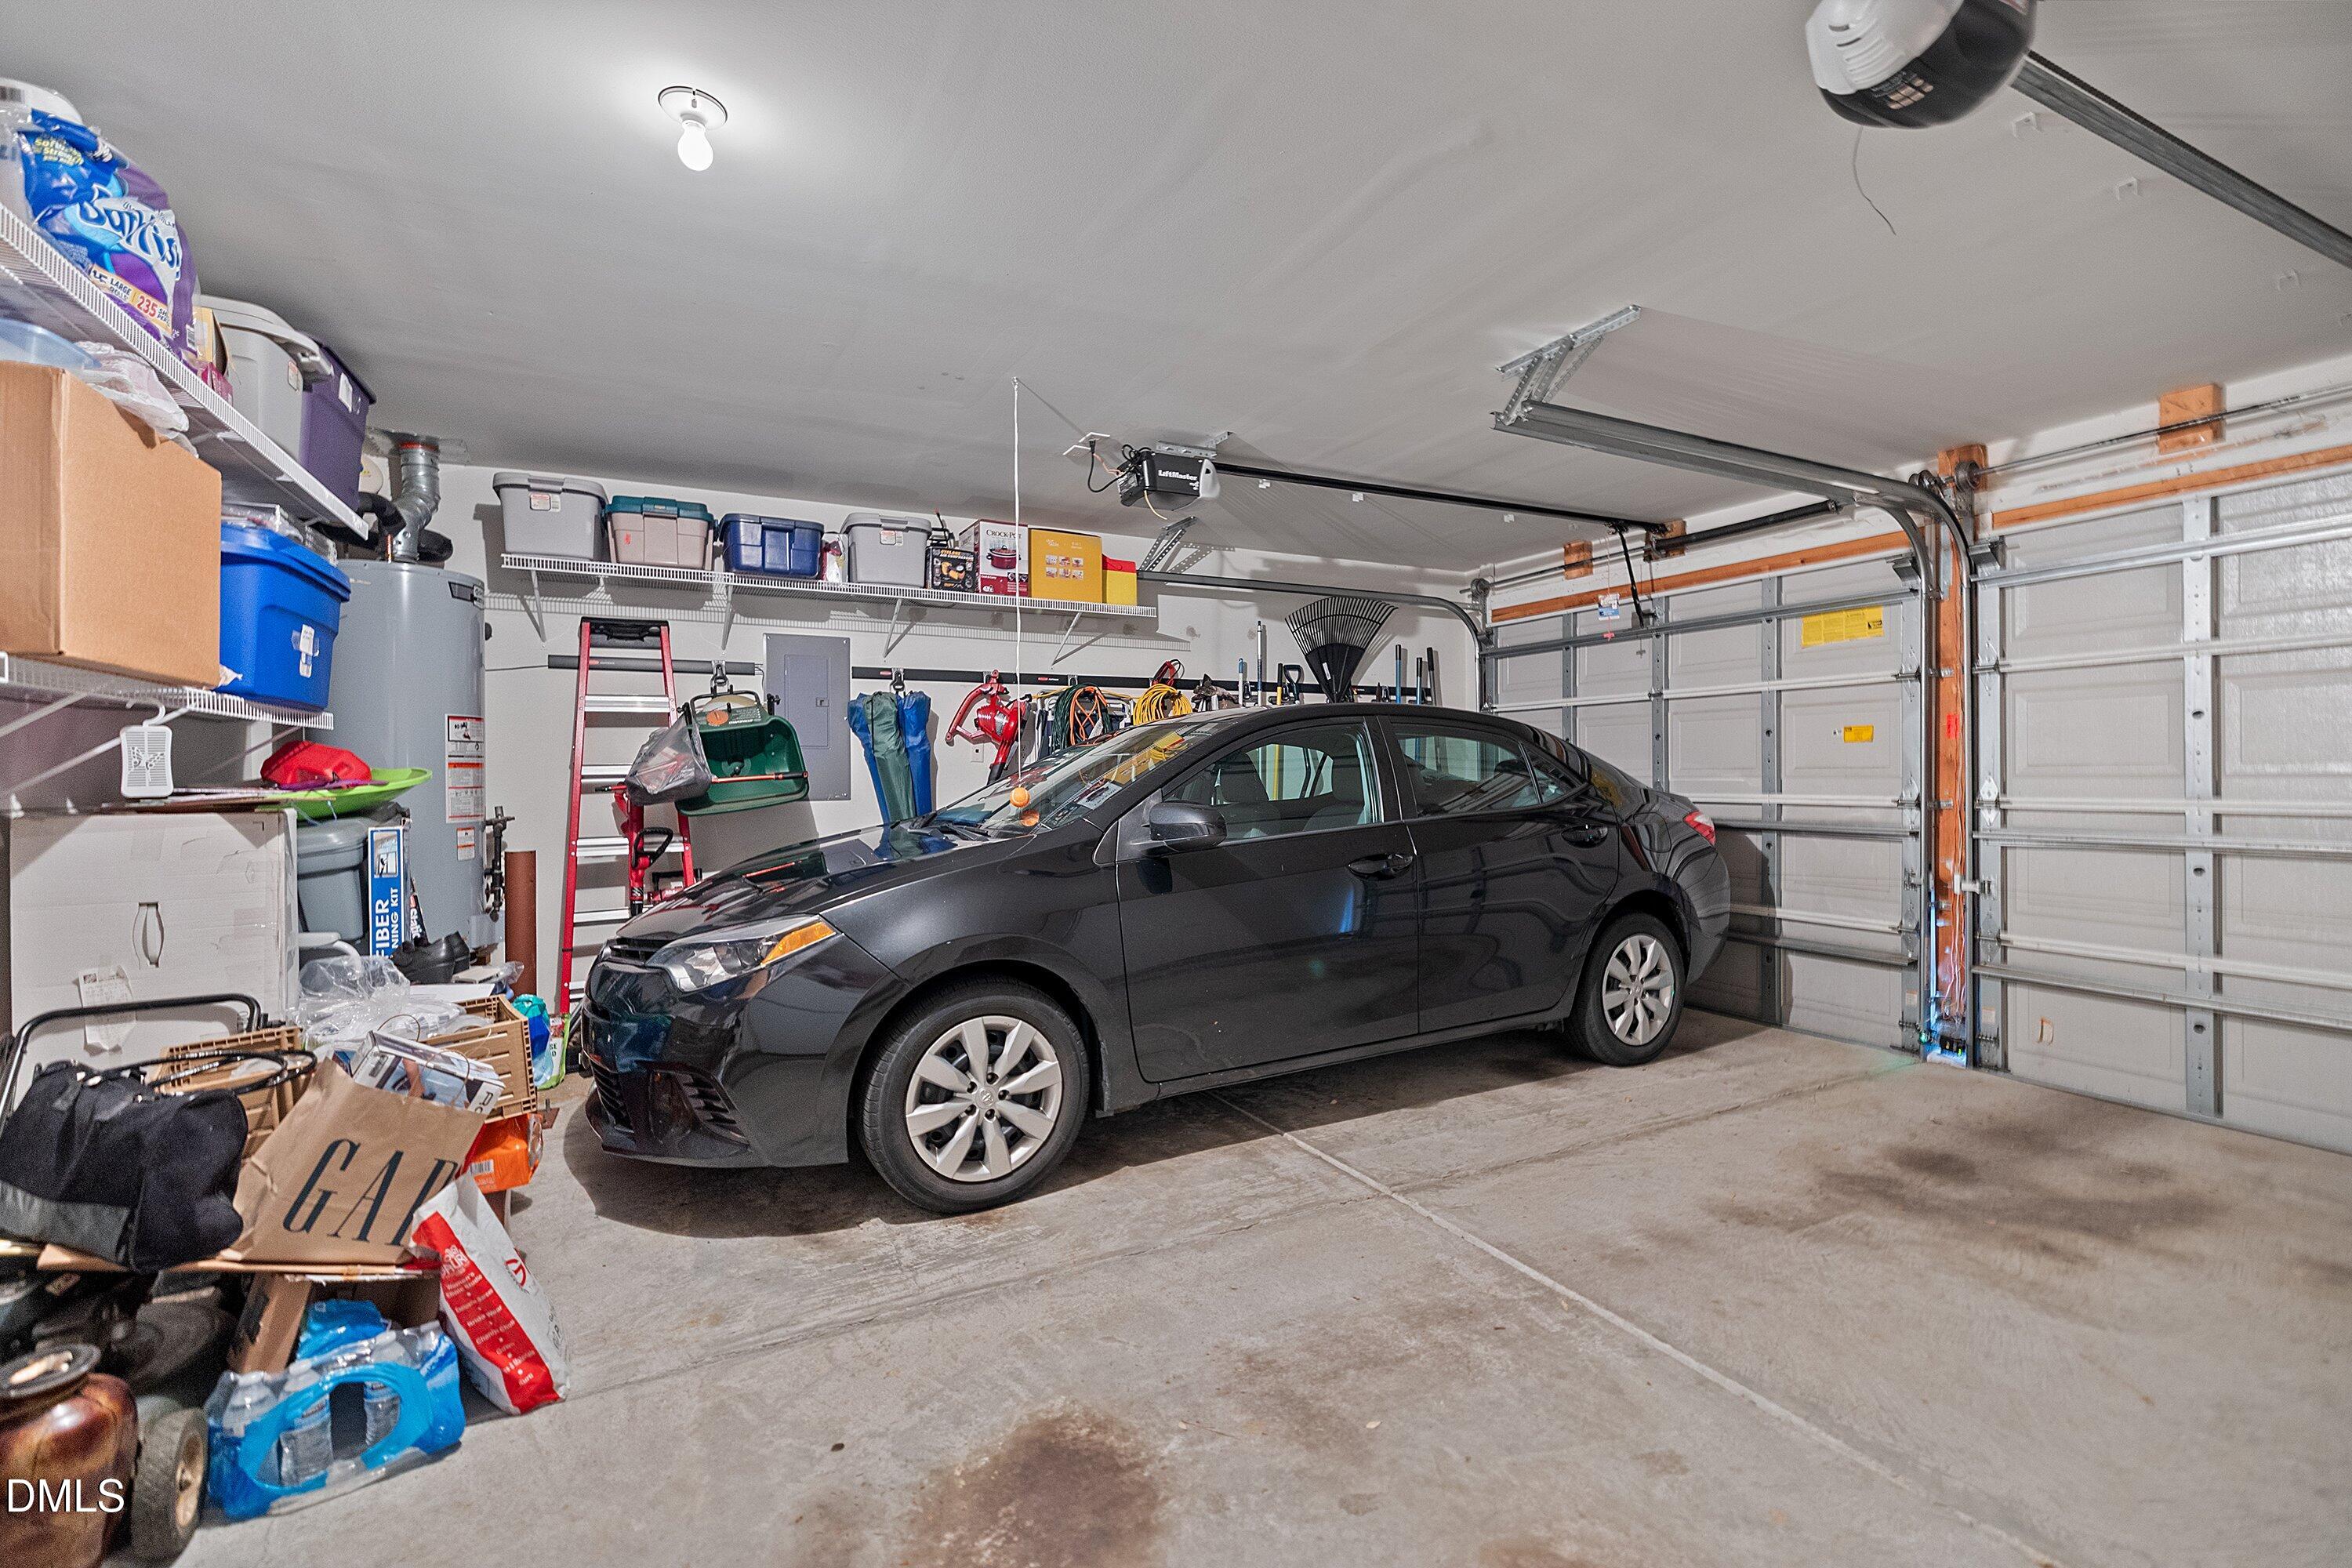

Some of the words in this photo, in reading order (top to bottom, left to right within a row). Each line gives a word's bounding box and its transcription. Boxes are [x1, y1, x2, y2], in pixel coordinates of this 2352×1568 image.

[110, 277, 132, 296] LARGE
[136, 295, 158, 318] 235
[1157, 470, 1198, 481] LiftMaster
[376, 899, 390, 958] FIBER
[282, 1138, 459, 1246] GAP
